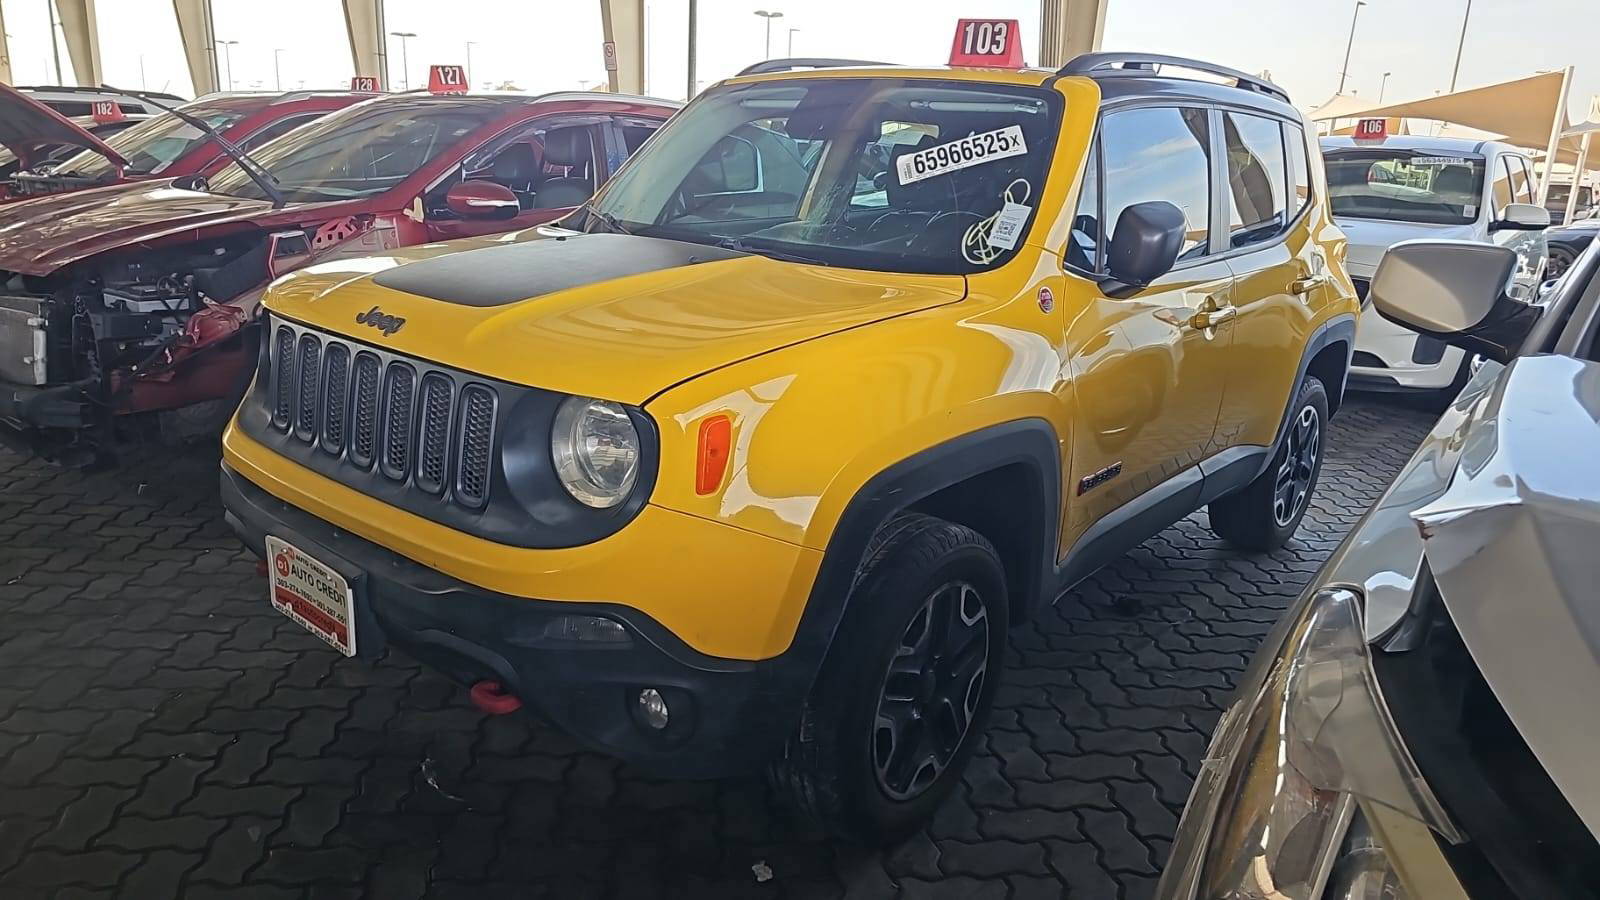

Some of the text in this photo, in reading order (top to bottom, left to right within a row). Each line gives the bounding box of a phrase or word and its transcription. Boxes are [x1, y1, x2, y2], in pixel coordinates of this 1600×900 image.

[964, 22, 1007, 55] 103
[355, 78, 373, 91] 128
[437, 67, 460, 85] 127
[96, 102, 113, 115] 182
[1362, 121, 1382, 133] 106
[356, 305, 406, 337] Jeep
[291, 563, 315, 587] AUTO
